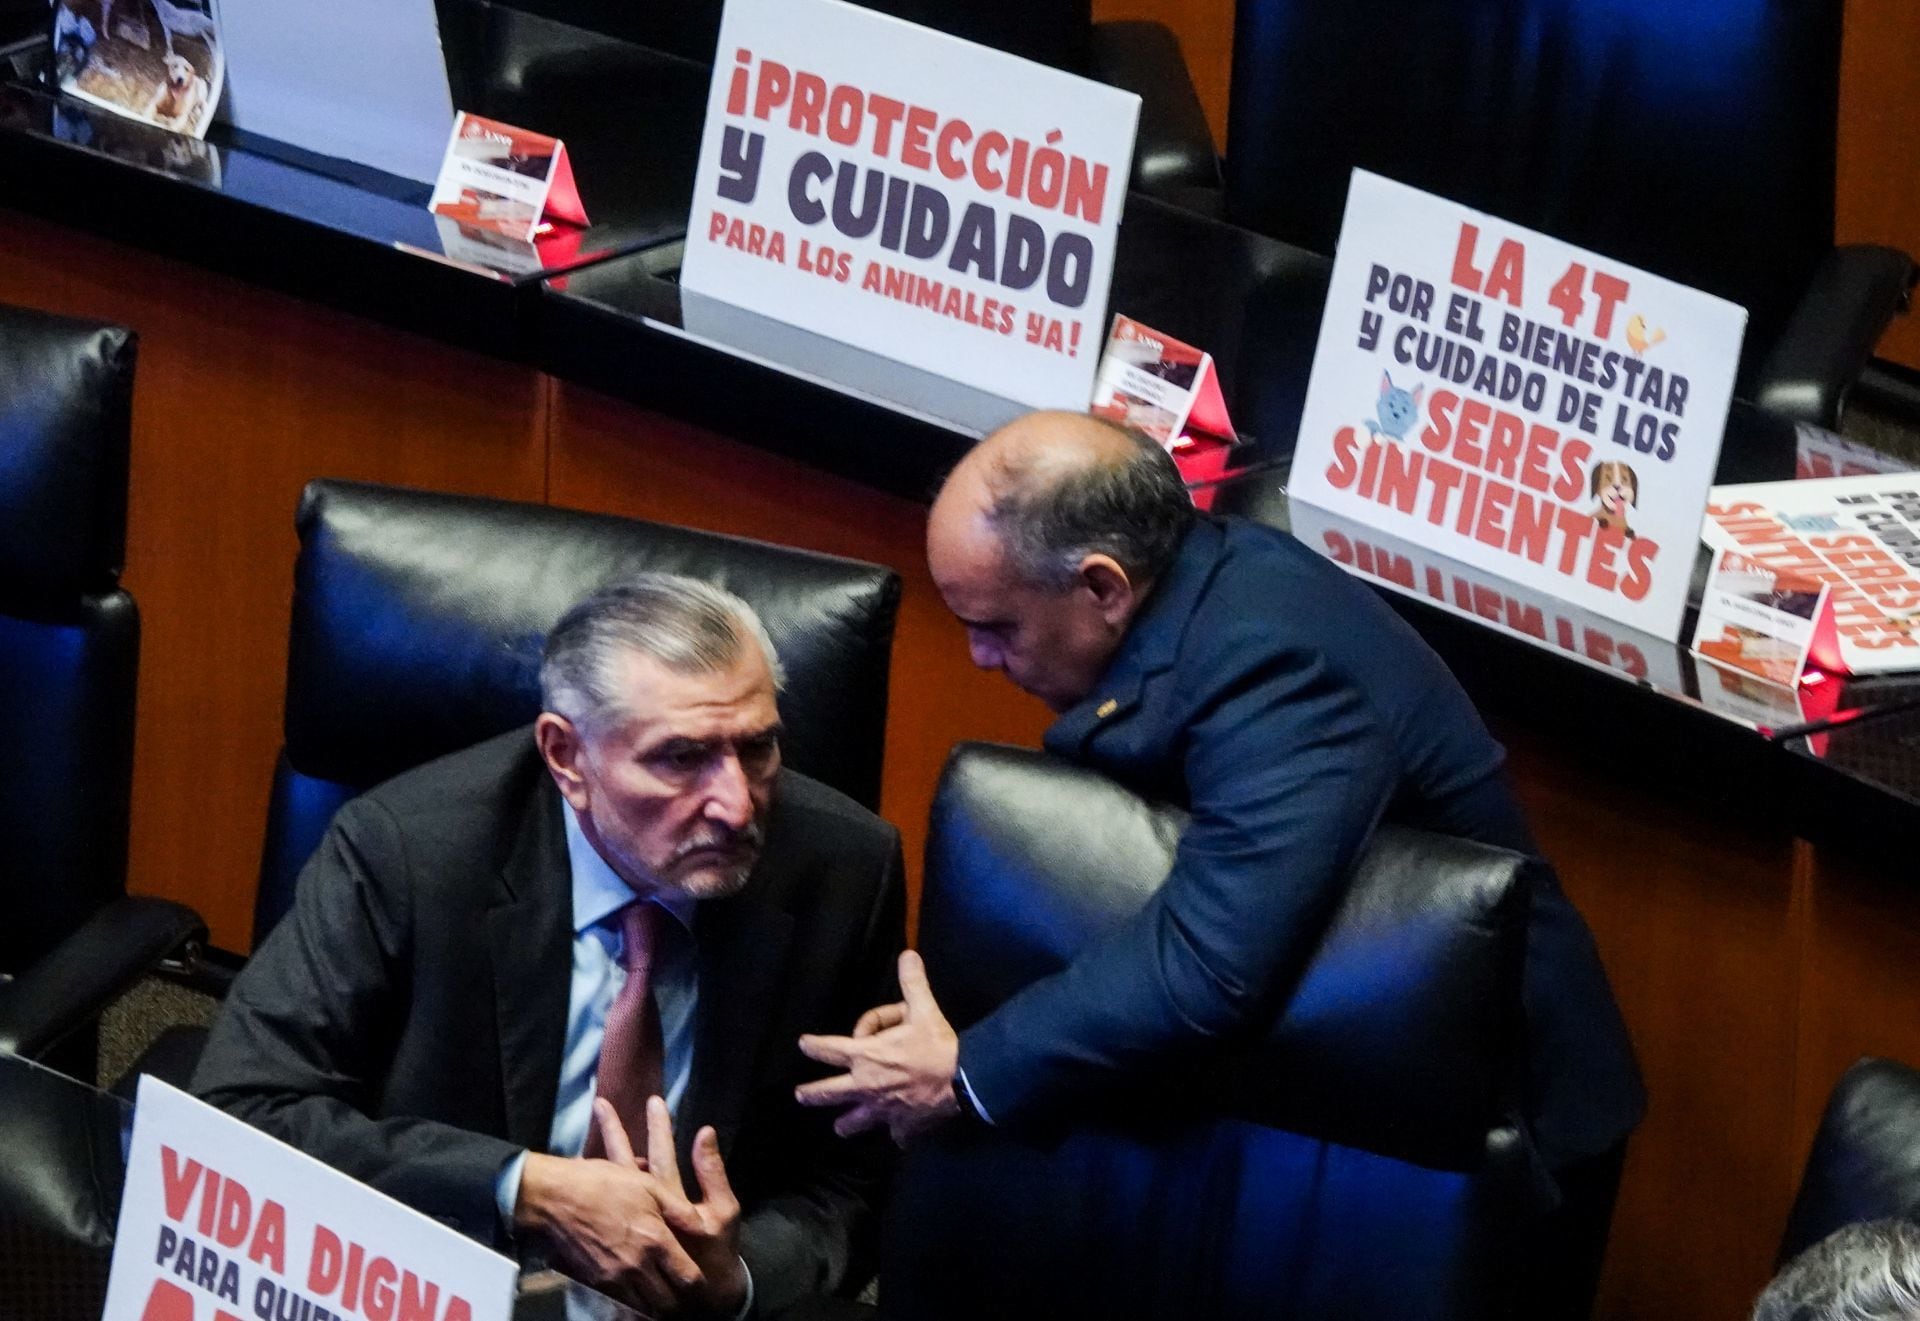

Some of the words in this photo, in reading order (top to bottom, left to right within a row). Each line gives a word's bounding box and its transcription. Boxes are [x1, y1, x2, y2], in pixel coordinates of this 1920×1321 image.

[727, 48, 1109, 225] ¡PROTECCIÓN
[708, 211, 785, 265] PARA
[798, 239, 852, 283] LOS
[862, 261, 1016, 335] ANIMALES
[1026, 312, 1081, 357] YA!
[717, 124, 765, 205] Y
[788, 151, 1093, 309] CUIDADO
[1451, 222, 1525, 308] LA
[1548, 262, 1630, 340] 4T
[1358, 309, 1383, 351] Y
[1394, 325, 1547, 413] CUIDADO
[1556, 382, 1603, 435] DE
[1611, 403, 1680, 461] LOS
[1366, 263, 1435, 323] POR
[1445, 292, 1485, 343] EL
[1498, 312, 1690, 417] BIENESTAR
[1325, 426, 1660, 601] SINTIENTES
[1420, 389, 1593, 503] SERES
[156, 1224, 240, 1306] PARA
[161, 1144, 285, 1276] VIDA
